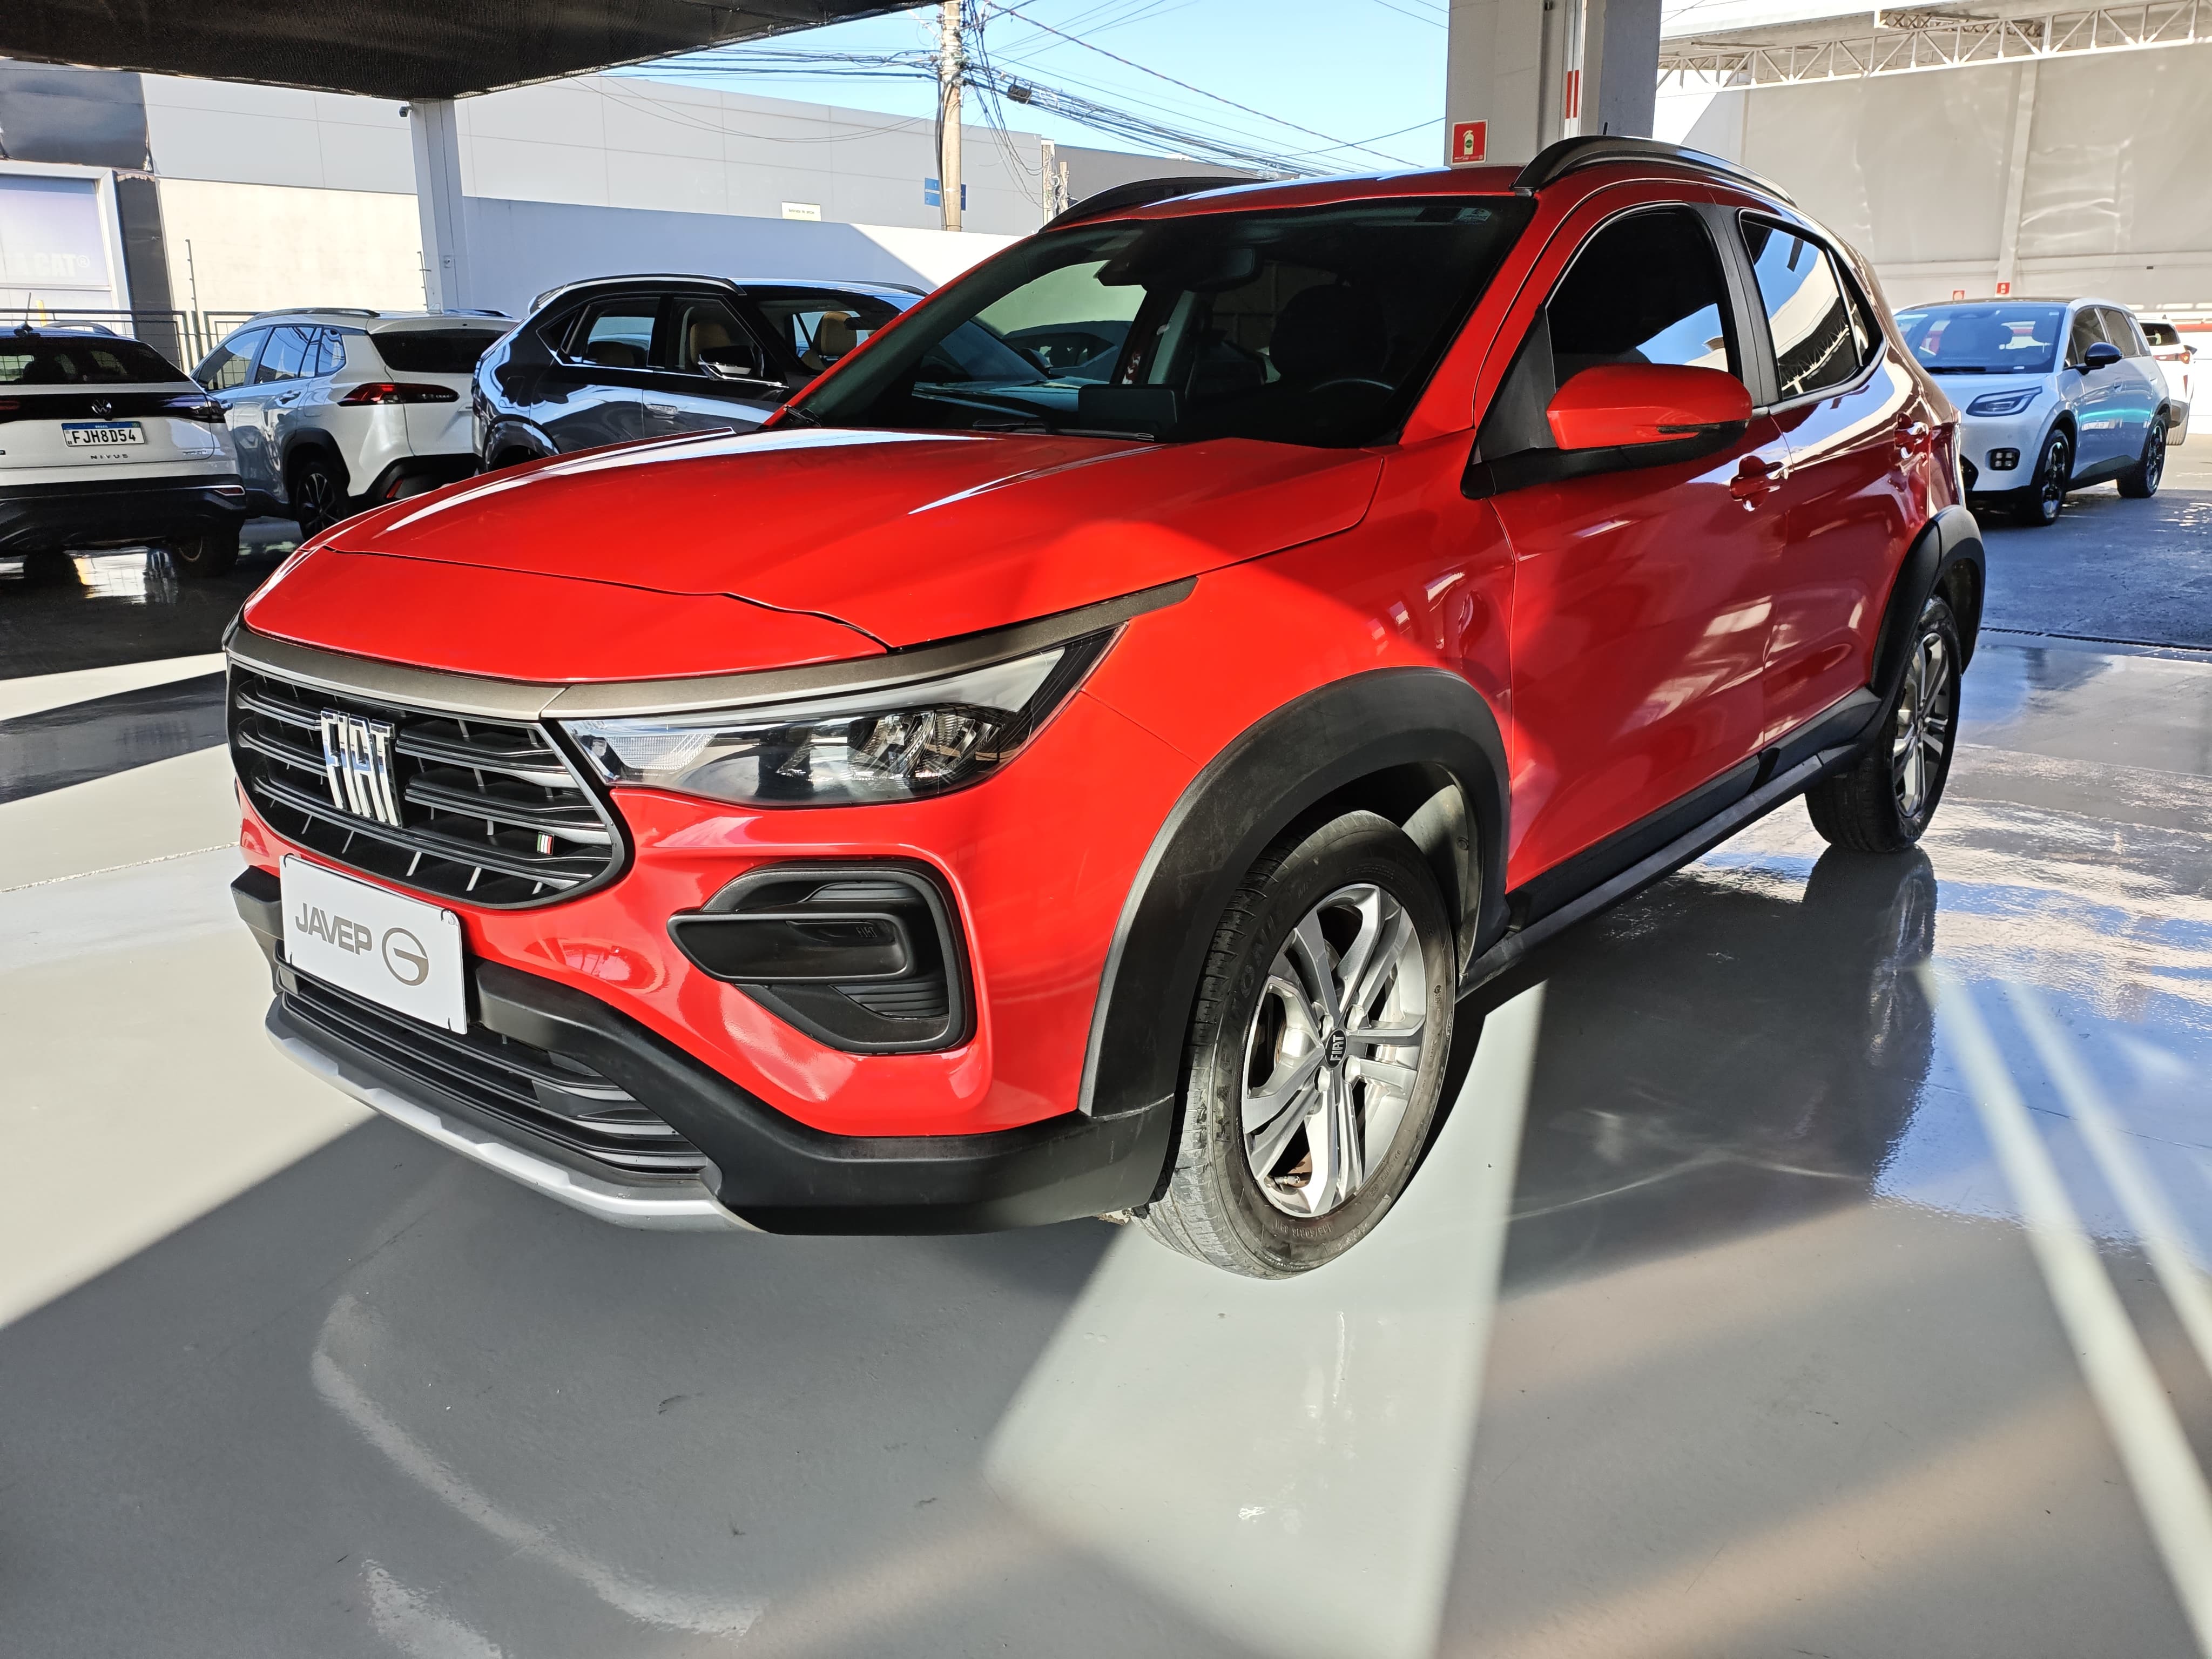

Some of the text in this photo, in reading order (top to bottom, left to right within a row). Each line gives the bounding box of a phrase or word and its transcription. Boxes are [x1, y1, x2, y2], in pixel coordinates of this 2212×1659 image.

[71, 429, 137, 444] FJH8D54
[321, 709, 400, 827] FIAT
[295, 902, 373, 955] JAVEP
[856, 926, 878, 938] FIAT
[1330, 1034, 1344, 1061] FIAT
